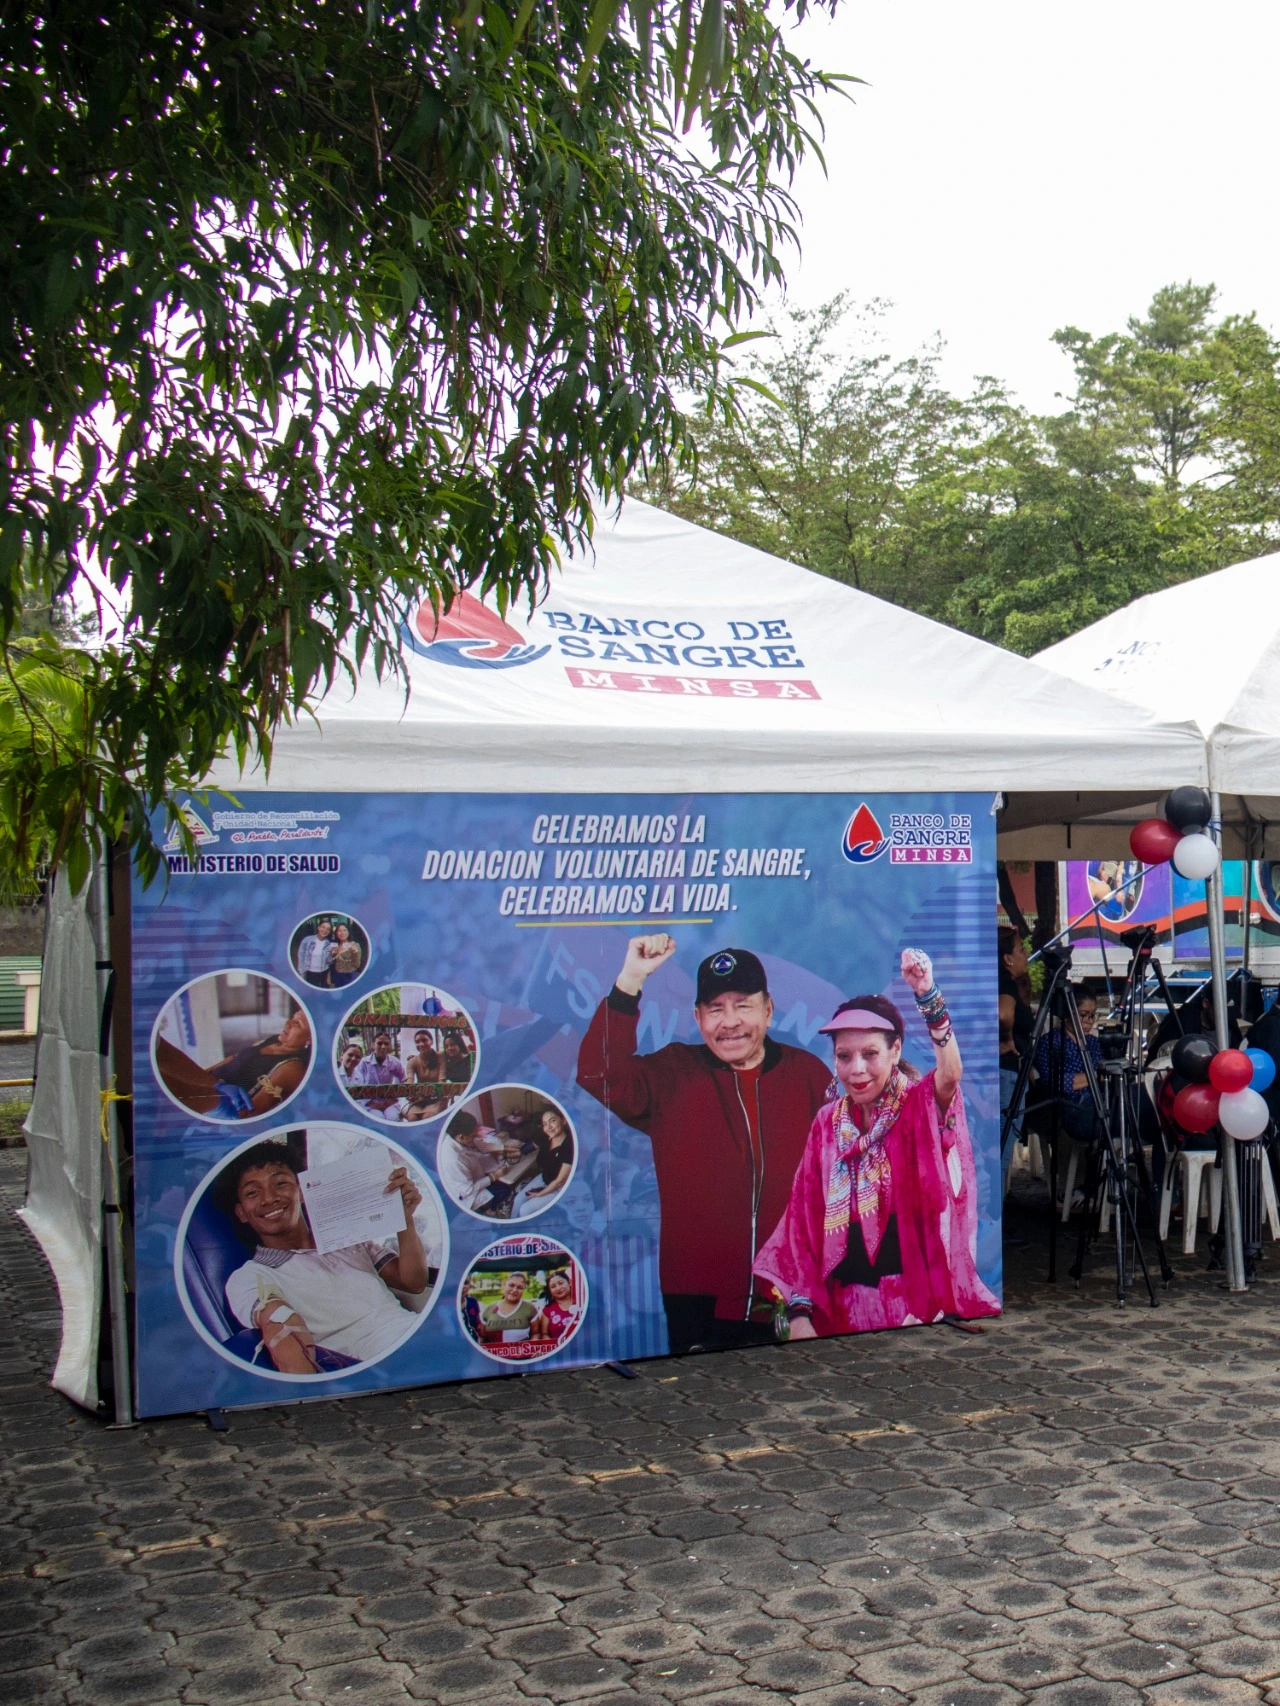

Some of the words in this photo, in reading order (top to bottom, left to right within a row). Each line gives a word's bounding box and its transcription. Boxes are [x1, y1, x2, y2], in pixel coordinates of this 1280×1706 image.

[543, 610, 705, 641] BANCO
[727, 618, 793, 641] DE
[559, 635, 805, 668] SANGRE
[576, 669, 812, 699] MINSA
[214, 811, 257, 821] Gobierno
[258, 811, 269, 820] de
[270, 811, 340, 820] Reconciliación
[890, 814, 945, 829] BANCO
[948, 813, 972, 829] DE
[214, 821, 221, 830] y
[223, 820, 255, 829] Unidad
[257, 820, 298, 829] Nacional
[532, 814, 677, 845] CELEBRAMOS
[680, 814, 706, 844] LA
[891, 829, 971, 846] SANGRE
[266, 855, 288, 872] DE
[289, 855, 340, 873] SALUD
[893, 848, 968, 863] MINSA
[422, 849, 543, 881] DONACION
[555, 848, 688, 881] VOLUNTARIA
[690, 849, 718, 878] DE
[722, 848, 812, 882] SANGRE,
[499, 884, 646, 917] CELEBRAMOS
[648, 885, 676, 913] LA
[681, 883, 738, 912] VIDA.
[350, 1014, 399, 1026] ONAR
[526, 1243, 538, 1254] DE
